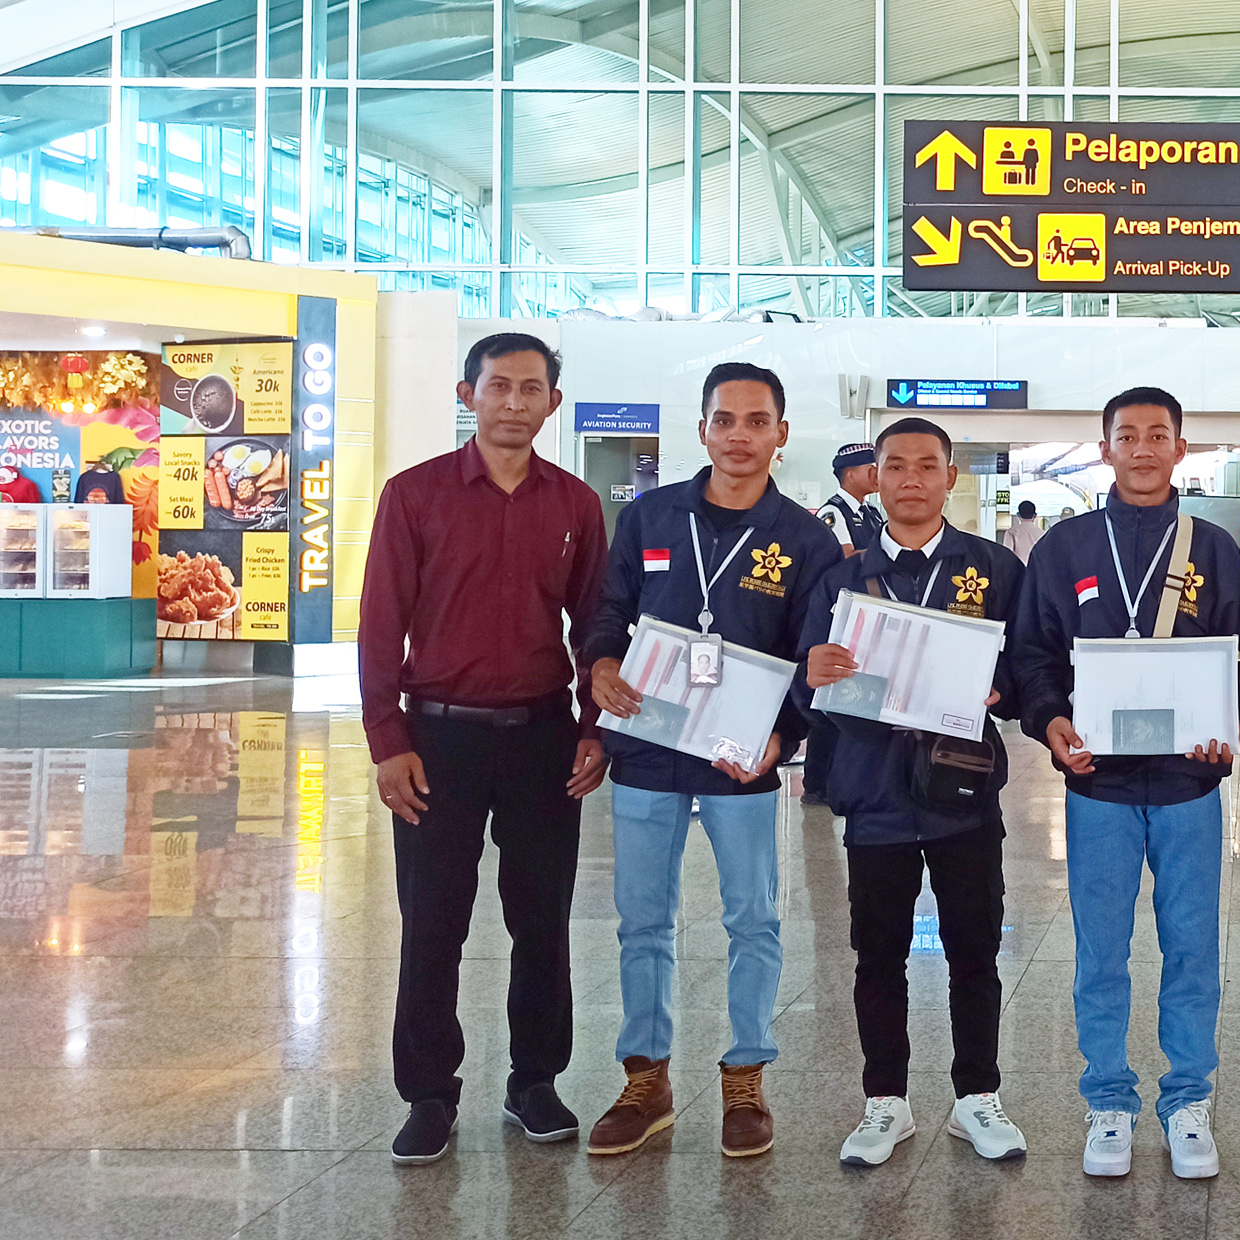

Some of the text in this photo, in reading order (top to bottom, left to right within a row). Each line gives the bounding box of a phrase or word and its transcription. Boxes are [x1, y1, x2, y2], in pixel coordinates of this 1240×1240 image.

[1064, 132, 1239, 169] Pelaporan
[1063, 177, 1116, 195] Check
[1131, 177, 1146, 195] in
[1113, 217, 1163, 236] Area
[1113, 259, 1231, 280] Arrival Pick-Up
[171, 352, 214, 364] CORNER
[255, 378, 280, 393] 30k
[917, 381, 955, 391] Pelayanan
[582, 420, 652, 429] AVIATION SECURITY
[0, 435, 59, 450] AVORS
[172, 451, 193, 459] Savory
[173, 466, 199, 481] 40k
[299, 342, 333, 592] TRAVEL TO GO
[172, 505, 196, 519] 60k
[245, 601, 286, 612] CORNER
